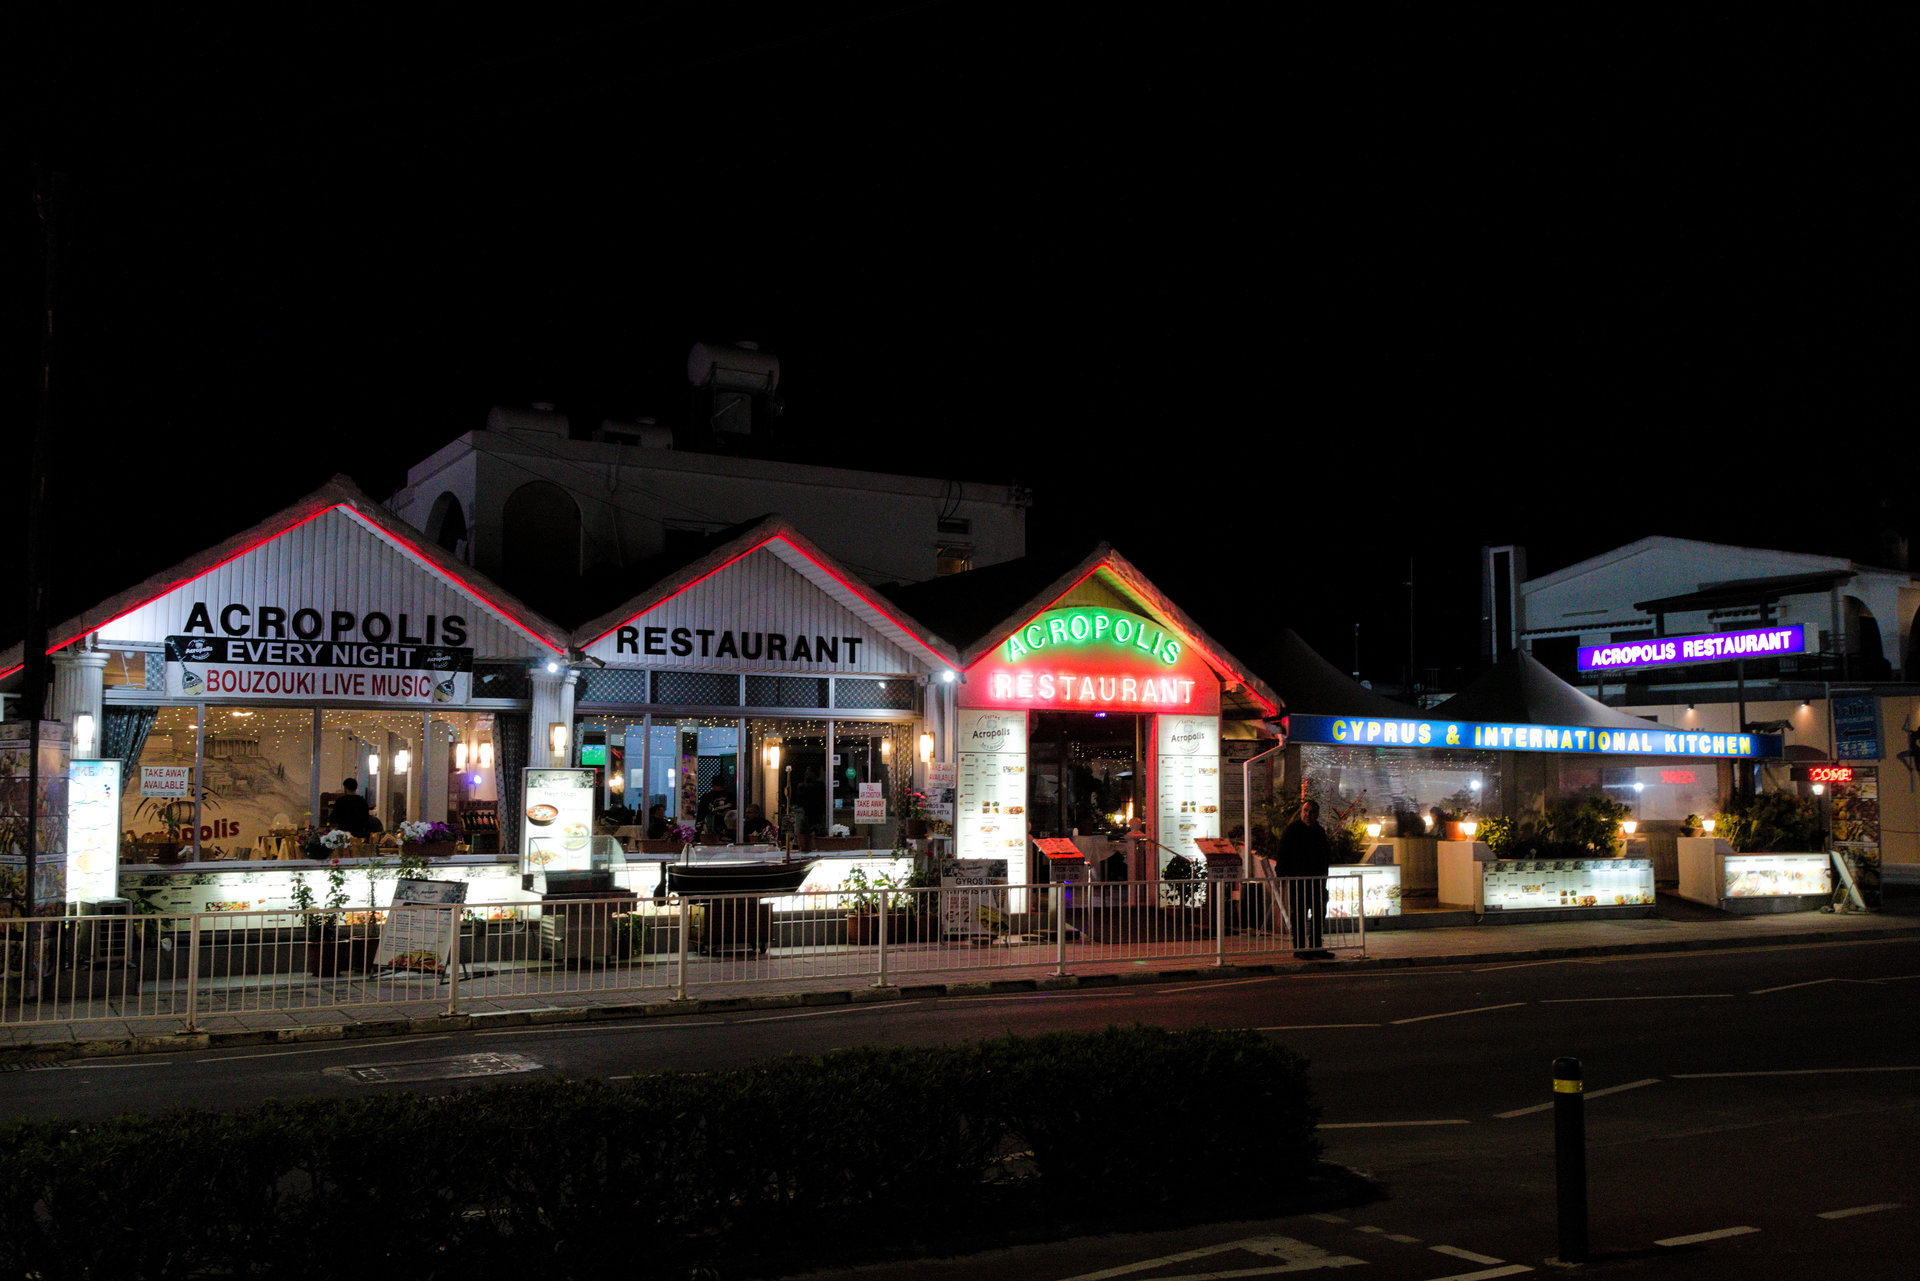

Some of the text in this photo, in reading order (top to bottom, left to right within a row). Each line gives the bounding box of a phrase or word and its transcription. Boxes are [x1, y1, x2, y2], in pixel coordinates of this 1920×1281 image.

[183, 602, 467, 646] ACROPOLIS
[227, 640, 416, 667] EVERY NIGHT
[616, 626, 862, 664] RESTAURANT
[1007, 615, 1181, 665] ACROPOLIS
[1592, 631, 1791, 666] ACROPOLIS RESTAURANT
[207, 669, 430, 697] BOUZOUKI LIVE MUSIC
[995, 674, 1195, 703] RESTAURANT
[972, 728, 1010, 739] Acropolis
[1171, 732, 1204, 742] Acropolis
[1333, 720, 1751, 754] CYPRUS & INTERNATIONAL KITCHEN
[143, 780, 184, 790] AVAILABLE
[144, 768, 186, 778] TAKE AWAY
[955, 877, 983, 886] GYROS
